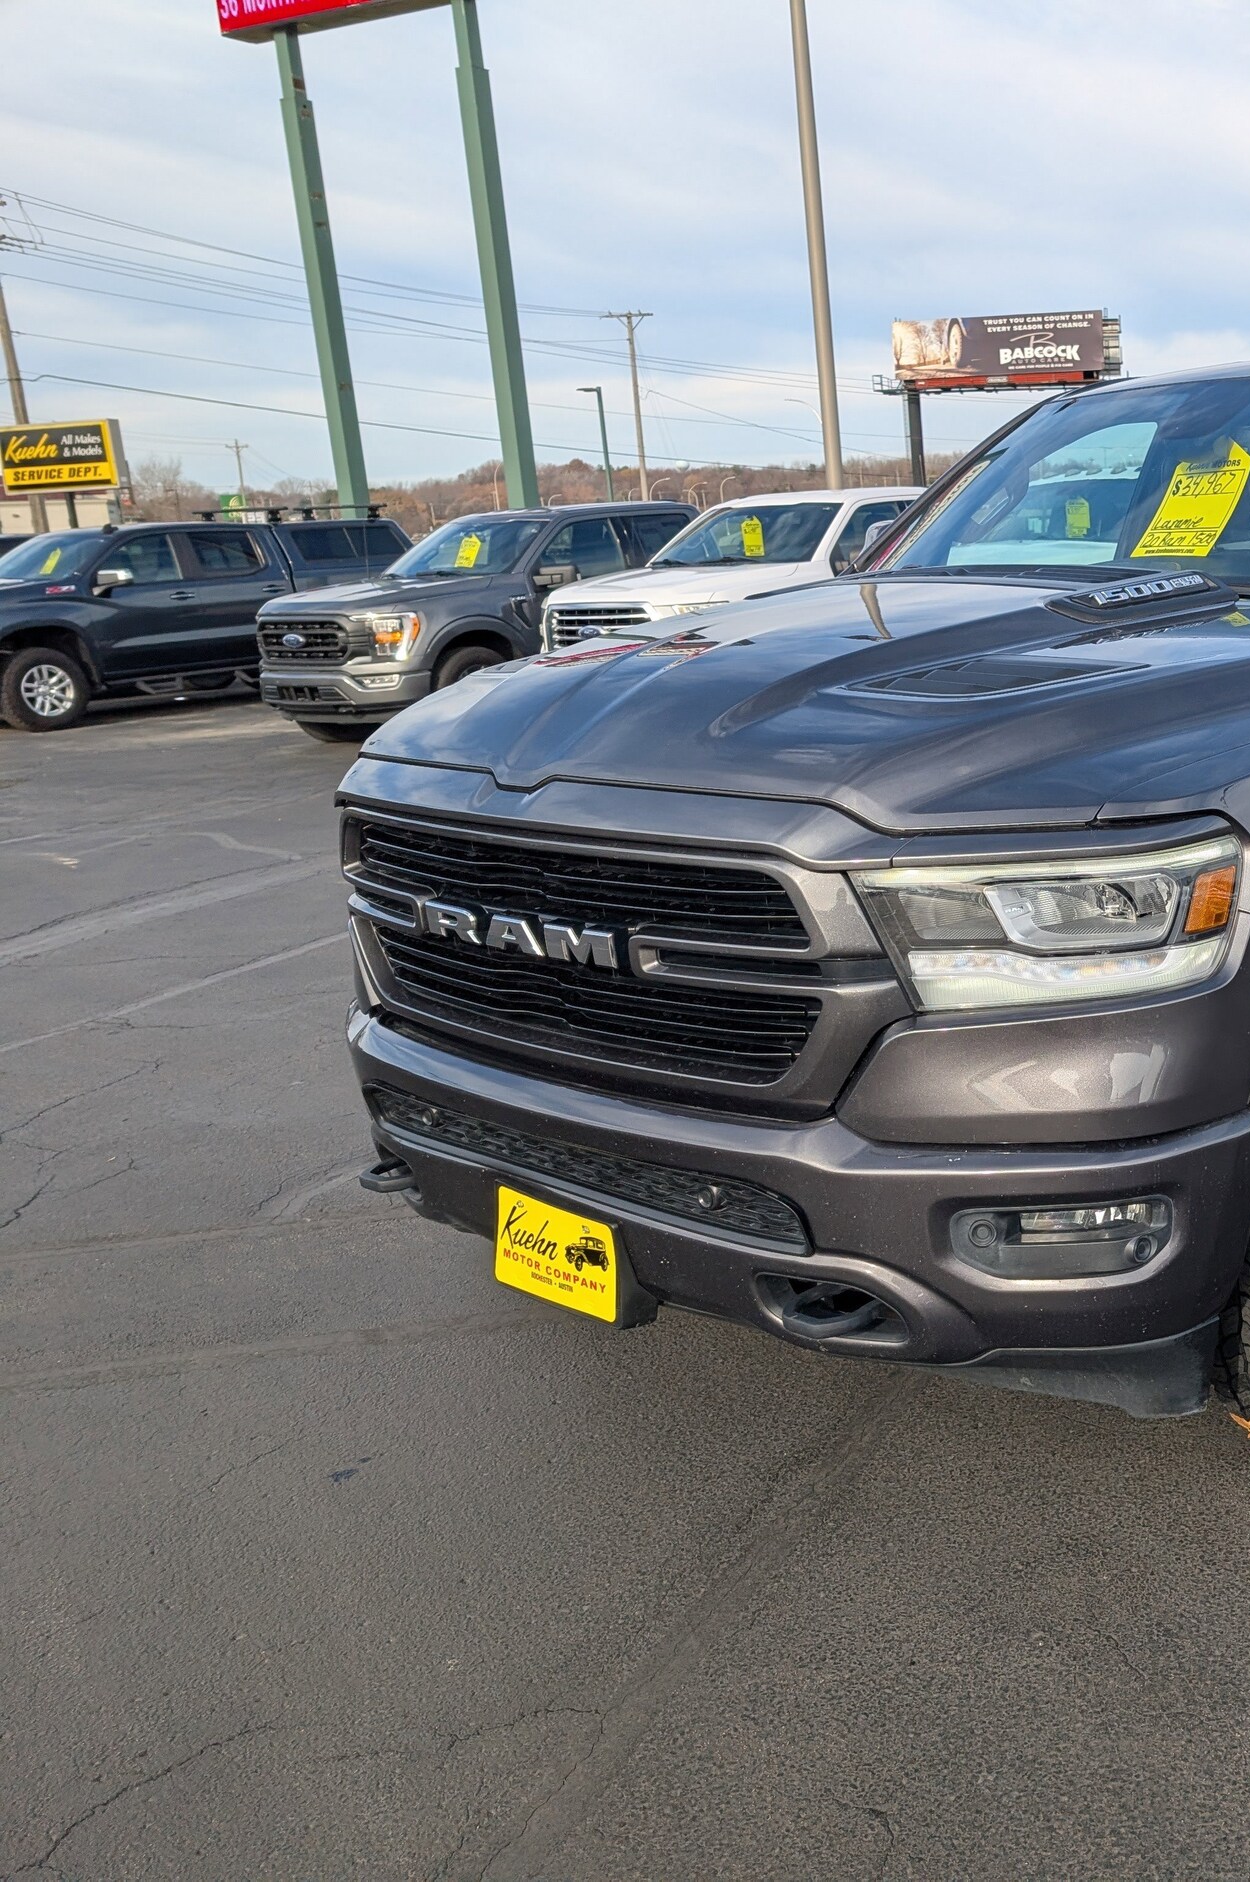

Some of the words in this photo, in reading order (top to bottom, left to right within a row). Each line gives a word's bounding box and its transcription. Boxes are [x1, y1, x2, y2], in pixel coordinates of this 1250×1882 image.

[999, 344, 1080, 365] BABCOCK
[5, 433, 58, 463] Kuehn
[61, 434, 73, 444] All
[75, 433, 101, 444] Makes
[63, 448, 70, 457] &
[72, 445, 103, 456] Models
[1211, 459, 1241, 468] MOTORS
[13, 468, 63, 482] SERVICE
[68, 465, 102, 478] DEPT.
[1155, 516, 1204, 529] Laramie
[1143, 533, 1161, 547] 20
[1159, 532, 1187, 547] Ram
[1188, 531, 1216, 546] 1500
[1089, 580, 1173, 606] 1500
[425, 899, 618, 969] RAM
[500, 1204, 559, 1261] Kuehn
[503, 1247, 541, 1272] MOTOR
[545, 1264, 607, 1294] COMPANY
